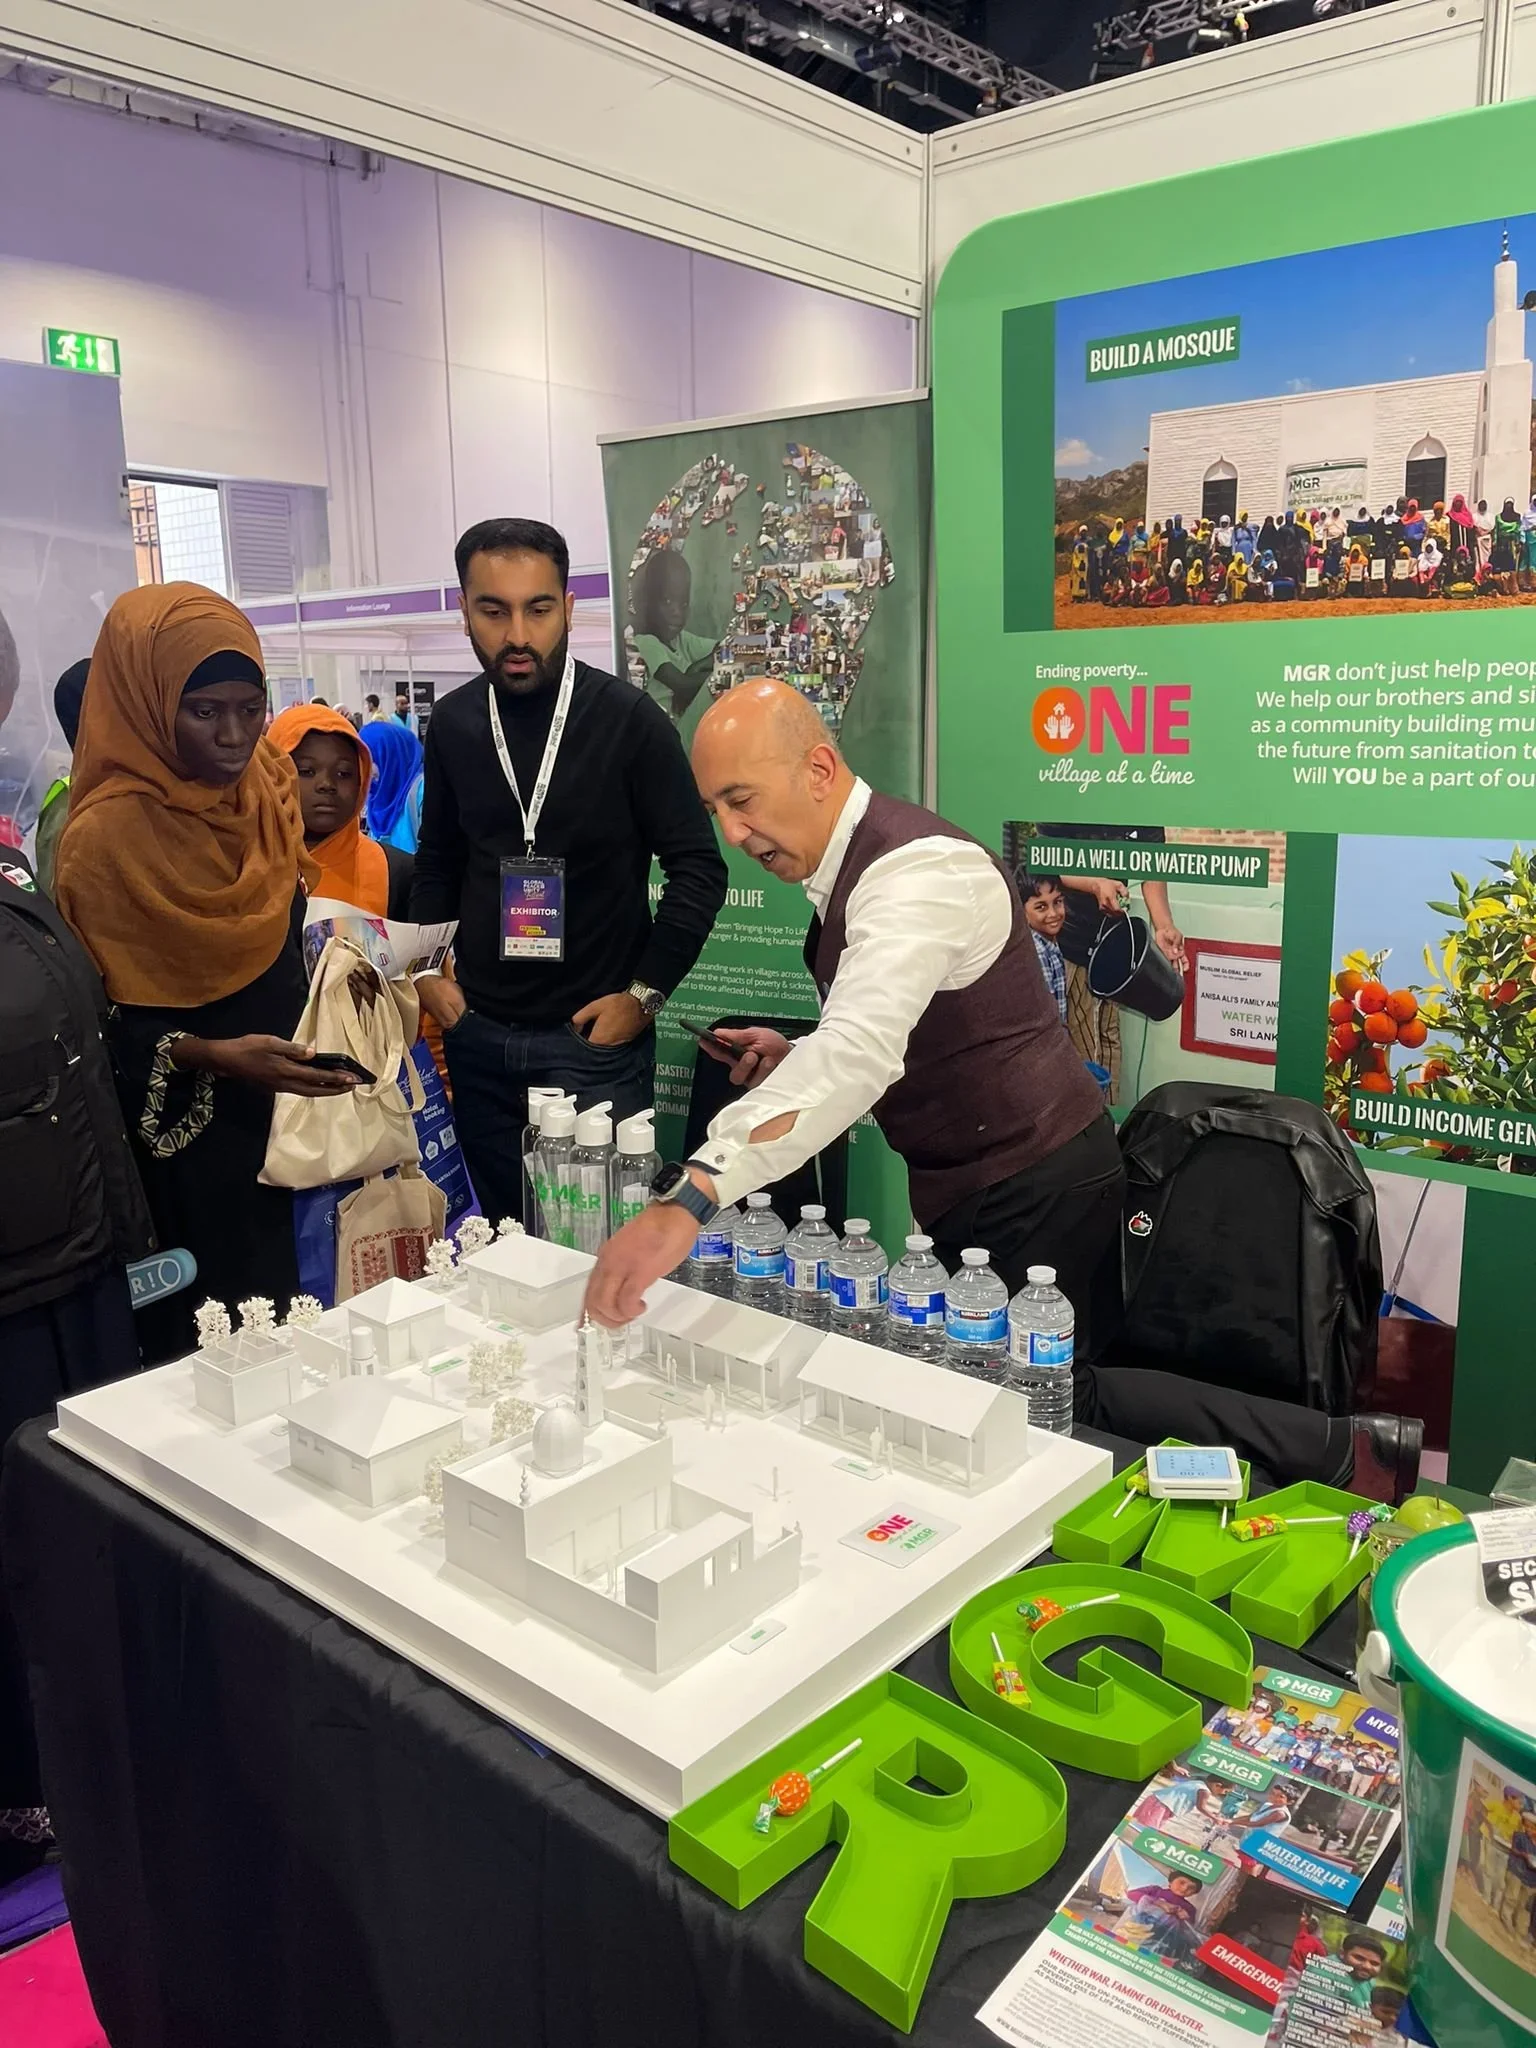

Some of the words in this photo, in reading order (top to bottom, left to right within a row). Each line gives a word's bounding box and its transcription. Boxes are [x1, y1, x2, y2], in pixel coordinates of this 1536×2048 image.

[1090, 343, 1140, 373] BUILD
[1142, 340, 1154, 364] A
[1157, 326, 1236, 362] MOSQUE
[1036, 664, 1081, 682] Ending
[1083, 663, 1149, 681] poverty...
[1283, 664, 1331, 682] MGR
[1335, 662, 1386, 681] don't
[1388, 661, 1429, 684] just
[1434, 658, 1481, 683] help
[1256, 691, 1285, 708] We
[1290, 690, 1331, 711] help
[1336, 693, 1371, 707] our
[1375, 688, 1465, 706] brothers
[1470, 686, 1512, 705] and
[1031, 684, 1192, 755] ONE
[1251, 719, 1271, 733] as
[1275, 720, 1286, 733] a
[1291, 715, 1402, 737] community
[1407, 713, 1492, 737] building
[1257, 741, 1288, 759] the
[1292, 740, 1351, 759] future
[1356, 741, 1404, 759] from
[1409, 741, 1517, 760] sanitation
[1038, 758, 1102, 794] village
[1105, 760, 1128, 784] at
[1132, 771, 1146, 783] a
[1150, 760, 1196, 785] time
[1293, 767, 1327, 784] Will
[1332, 767, 1377, 784] YOU
[1382, 767, 1407, 785] be
[1412, 771, 1424, 786] a
[1430, 771, 1473, 791] part
[1479, 768, 1502, 787] of
[1030, 846, 1074, 868] BUILD
[1076, 849, 1086, 868] A
[1089, 849, 1127, 871] WELL
[1129, 850, 1151, 872] OR
[1155, 852, 1207, 876] WATER
[1210, 855, 1261, 879] PUMP
[741, 889, 764, 908] LIFE
[510, 907, 558, 917] EXHIBITOR
[715, 922, 731, 931] been
[764, 926, 783, 936] Hope
[785, 927, 794, 935] To
[740, 935, 772, 945] providing
[708, 973, 718, 981] the
[720, 975, 745, 985] impacts
[746, 977, 754, 985] of
[755, 979, 781, 990] poverty
[782, 981, 788, 989] &
[729, 965, 745, 973] work
[755, 968, 780, 979] villages
[781, 971, 803, 979] across
[1200, 965, 1220, 973] MUSLIM
[1221, 968, 1241, 976] GLOBAL
[690, 982, 697, 990] to
[699, 983, 716, 992] those
[718, 985, 745, 996] affected
[745, 987, 754, 998] by
[755, 989, 780, 999] natural
[1201, 992, 1220, 1001] ANISA
[1222, 995, 1239, 1003] ALI'S
[1240, 997, 1265, 1007] FAMILY
[696, 1003, 738, 1014] development
[1222, 1009, 1262, 1024] WATER
[1230, 1028, 1247, 1038] SRI
[1250, 1031, 1279, 1041] LANK
[1355, 1098, 1411, 1127] BUILD
[1414, 1107, 1495, 1140] INCOME
[865, 1514, 914, 1542] ONE
[907, 1527, 933, 1546] MGR
[1291, 1679, 1333, 1701] MGR
[1366, 1715, 1386, 1730] MY
[1218, 1759, 1262, 1783] MGR
[1165, 1845, 1213, 1875] MGR
[1262, 1839, 1301, 1867] WATER
[1299, 1855, 1327, 1877] FOR
[1323, 1871, 1350, 1890] LIFE
[1034, 1968, 1044, 1978] AS
[1044, 1975, 1078, 1996] POSSIBLE
[1049, 1947, 1090, 1976] WHETHER
[1088, 1968, 1112, 1988] WAR,
[1110, 1980, 1146, 2004] FAMINE
[1144, 1997, 1160, 2010] OR
[1038, 1964, 1069, 1985] PREVENT
[1069, 1982, 1089, 1994] LOSS
[1088, 1990, 1099, 1999] OF
[1098, 1995, 1115, 2007] LIFE
[1114, 2004, 1134, 2017] AND
[1132, 2012, 1161, 2032] REDUCE
[1042, 1959, 1059, 1972] OUR
[1058, 1967, 1097, 1991] DEDICATED
[1097, 1987, 1160, 2021] ON-THE-GROUND
[1160, 2017, 1185, 2035] TEAMS
